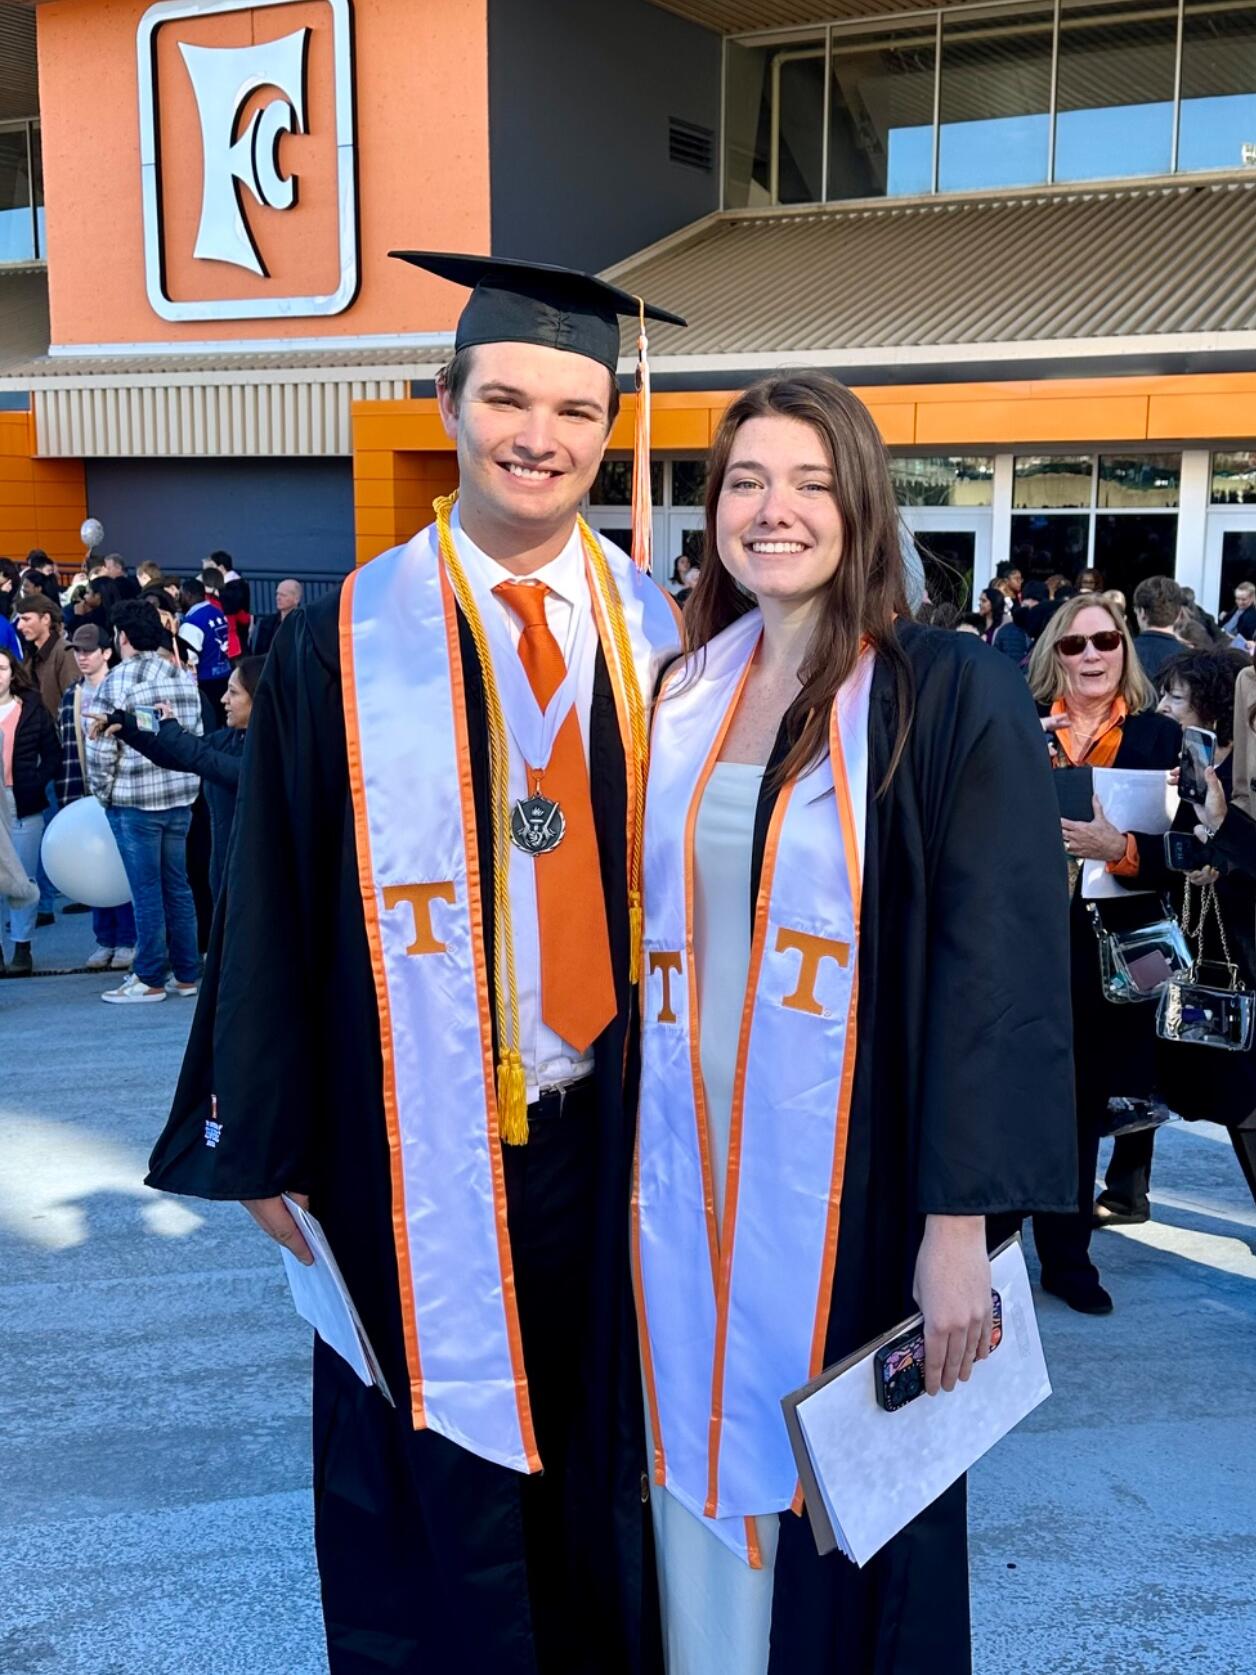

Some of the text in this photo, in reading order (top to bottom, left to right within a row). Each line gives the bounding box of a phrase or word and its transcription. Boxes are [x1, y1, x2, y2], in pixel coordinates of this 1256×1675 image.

[382, 881, 456, 955] T
[649, 951, 682, 1024] T
[775, 927, 850, 1015] T
